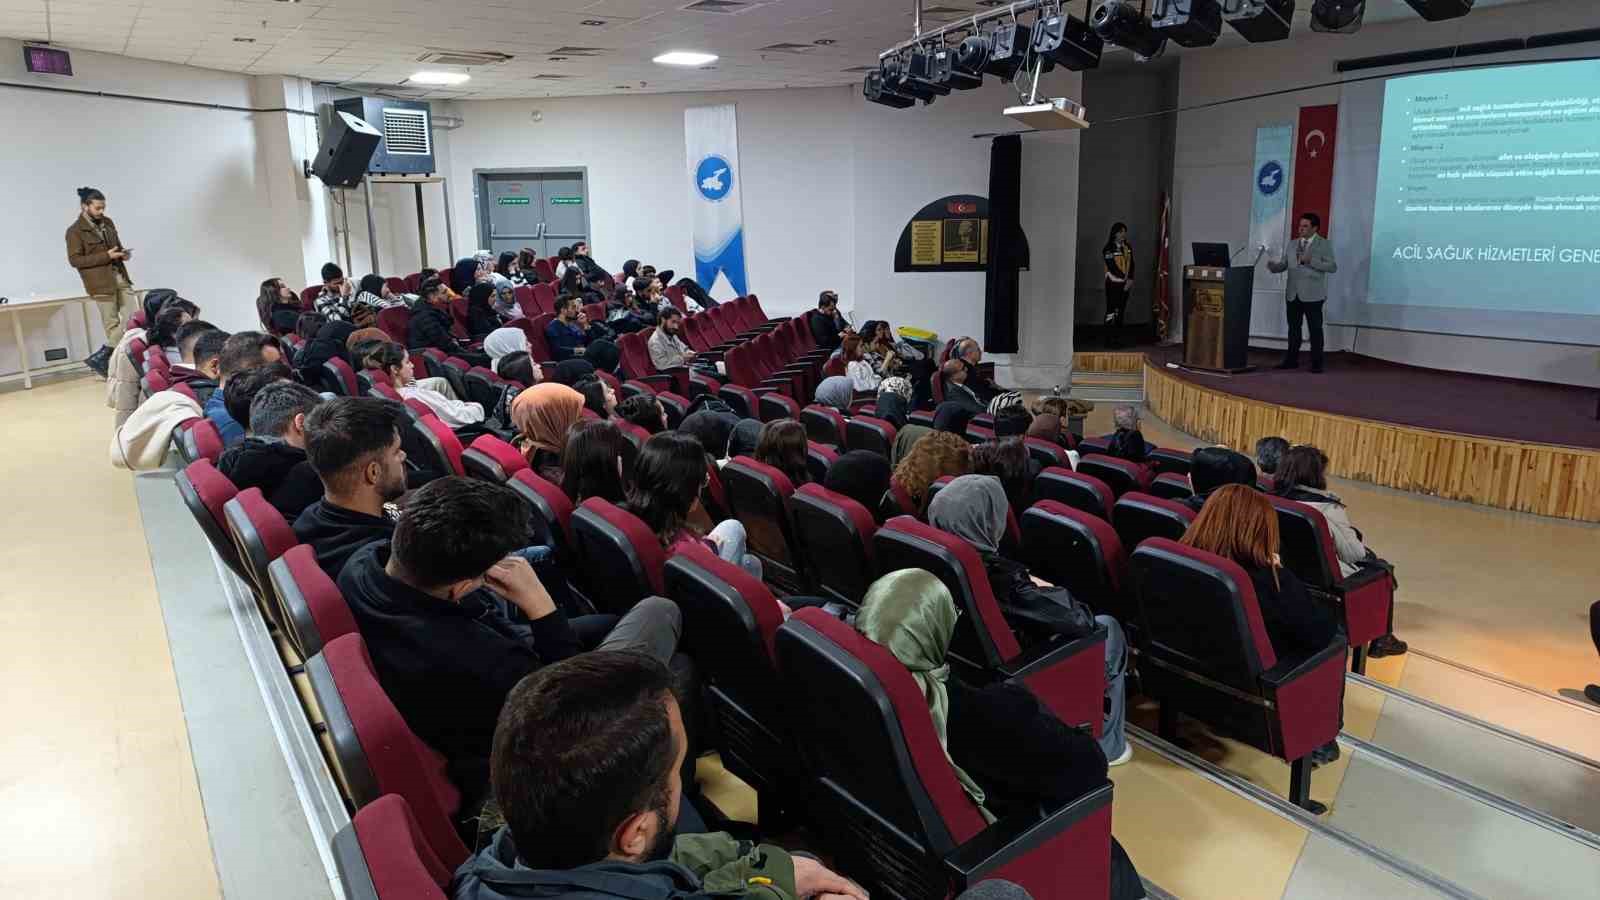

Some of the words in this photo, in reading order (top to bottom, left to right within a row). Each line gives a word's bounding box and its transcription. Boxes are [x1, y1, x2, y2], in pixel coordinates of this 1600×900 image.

[1392, 244, 1423, 260] ACİL
[1425, 244, 1474, 261] SAĞLIK
[1477, 245, 1556, 262] HİZMETLERİ
